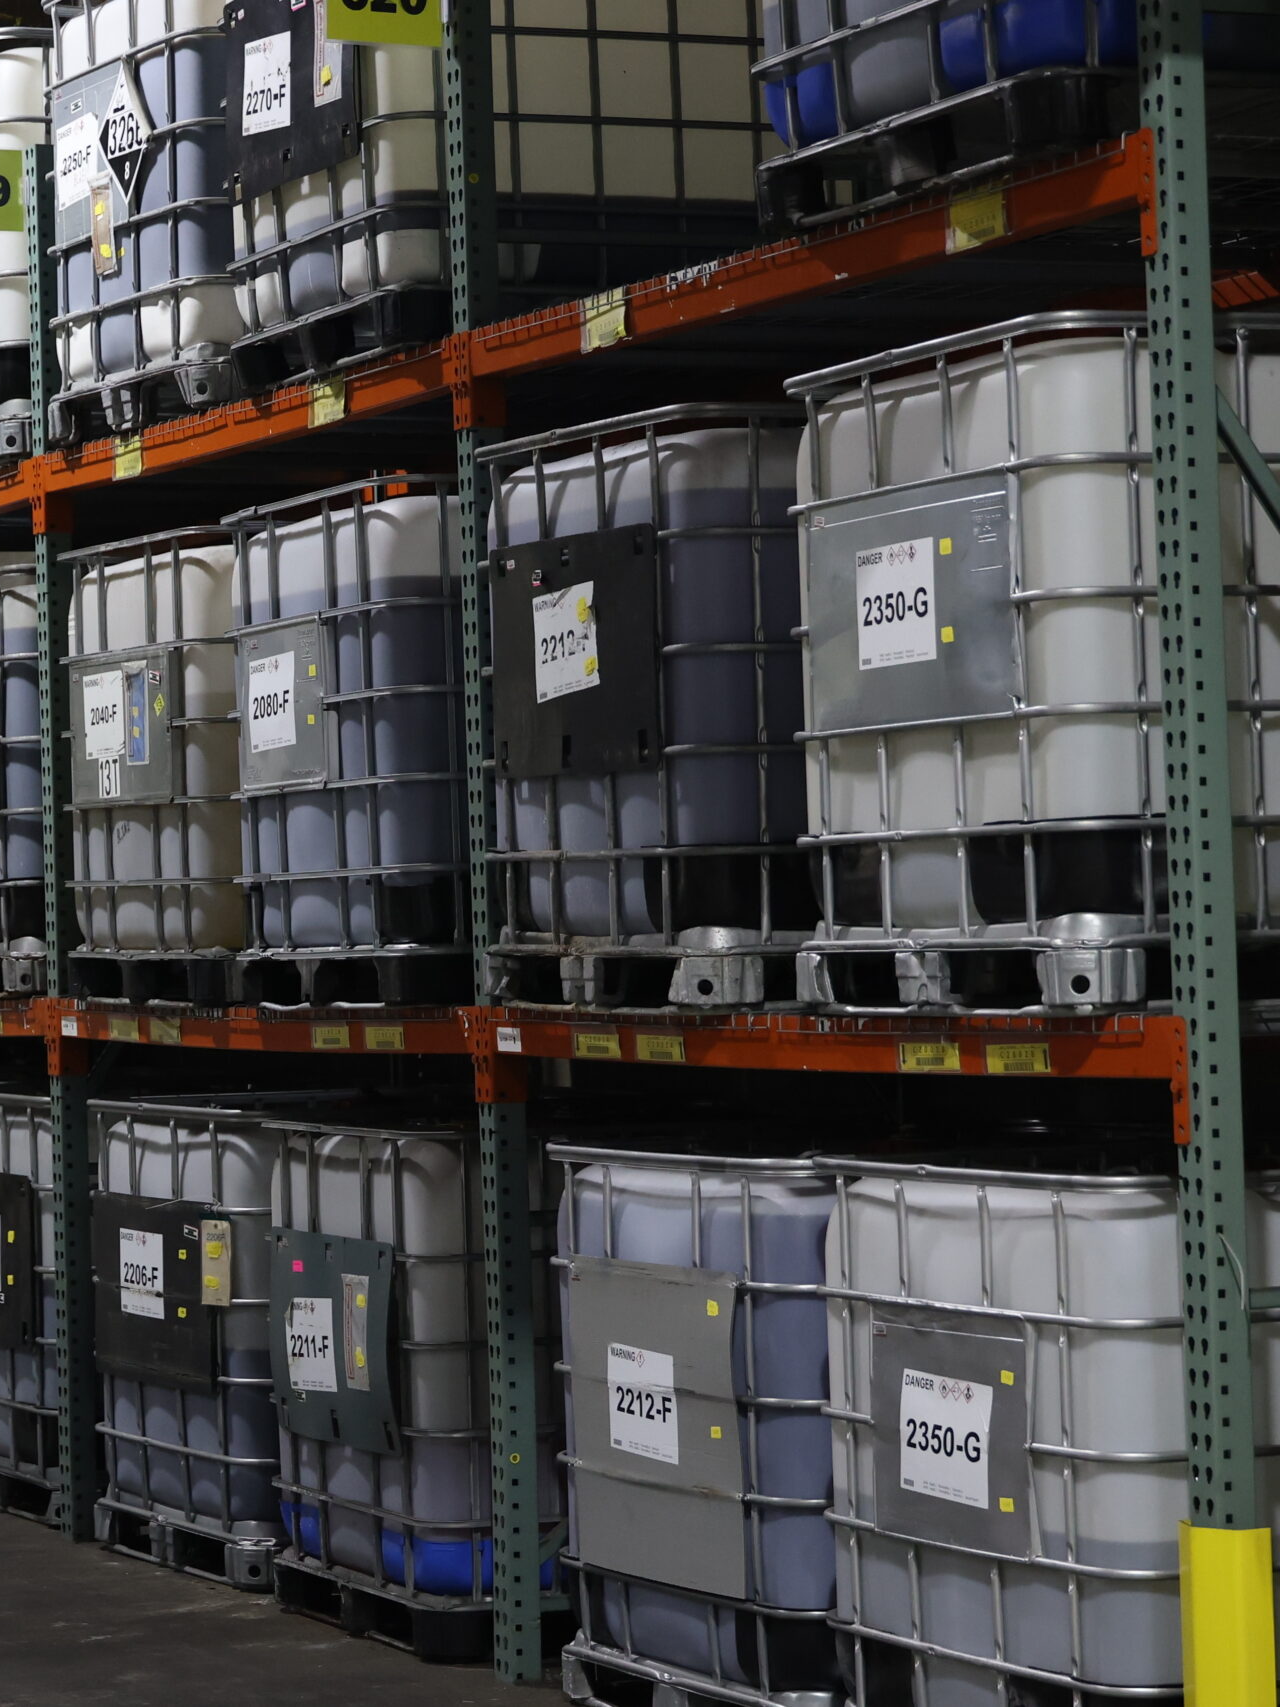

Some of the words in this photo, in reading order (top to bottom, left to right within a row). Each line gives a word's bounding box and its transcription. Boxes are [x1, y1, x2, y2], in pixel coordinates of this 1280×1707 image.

[246, 84, 286, 115] 2270-F
[63, 145, 91, 176] 2250-F
[124, 161, 131, 180] 8
[857, 552, 883, 567] DANGER
[863, 586, 929, 627] 2350-G
[250, 662, 266, 675] DANGER
[90, 704, 117, 726] 2040-F
[253, 689, 289, 720] 2080-F
[100, 759, 118, 797] 13T
[123, 1262, 158, 1287] 2206-F
[290, 1334, 329, 1359] 2211-F
[611, 1347, 635, 1362] WARNING
[905, 1374, 934, 1391] DANGER
[616, 1386, 672, 1423] 2212-F
[906, 1418, 981, 1463] 2350-G
